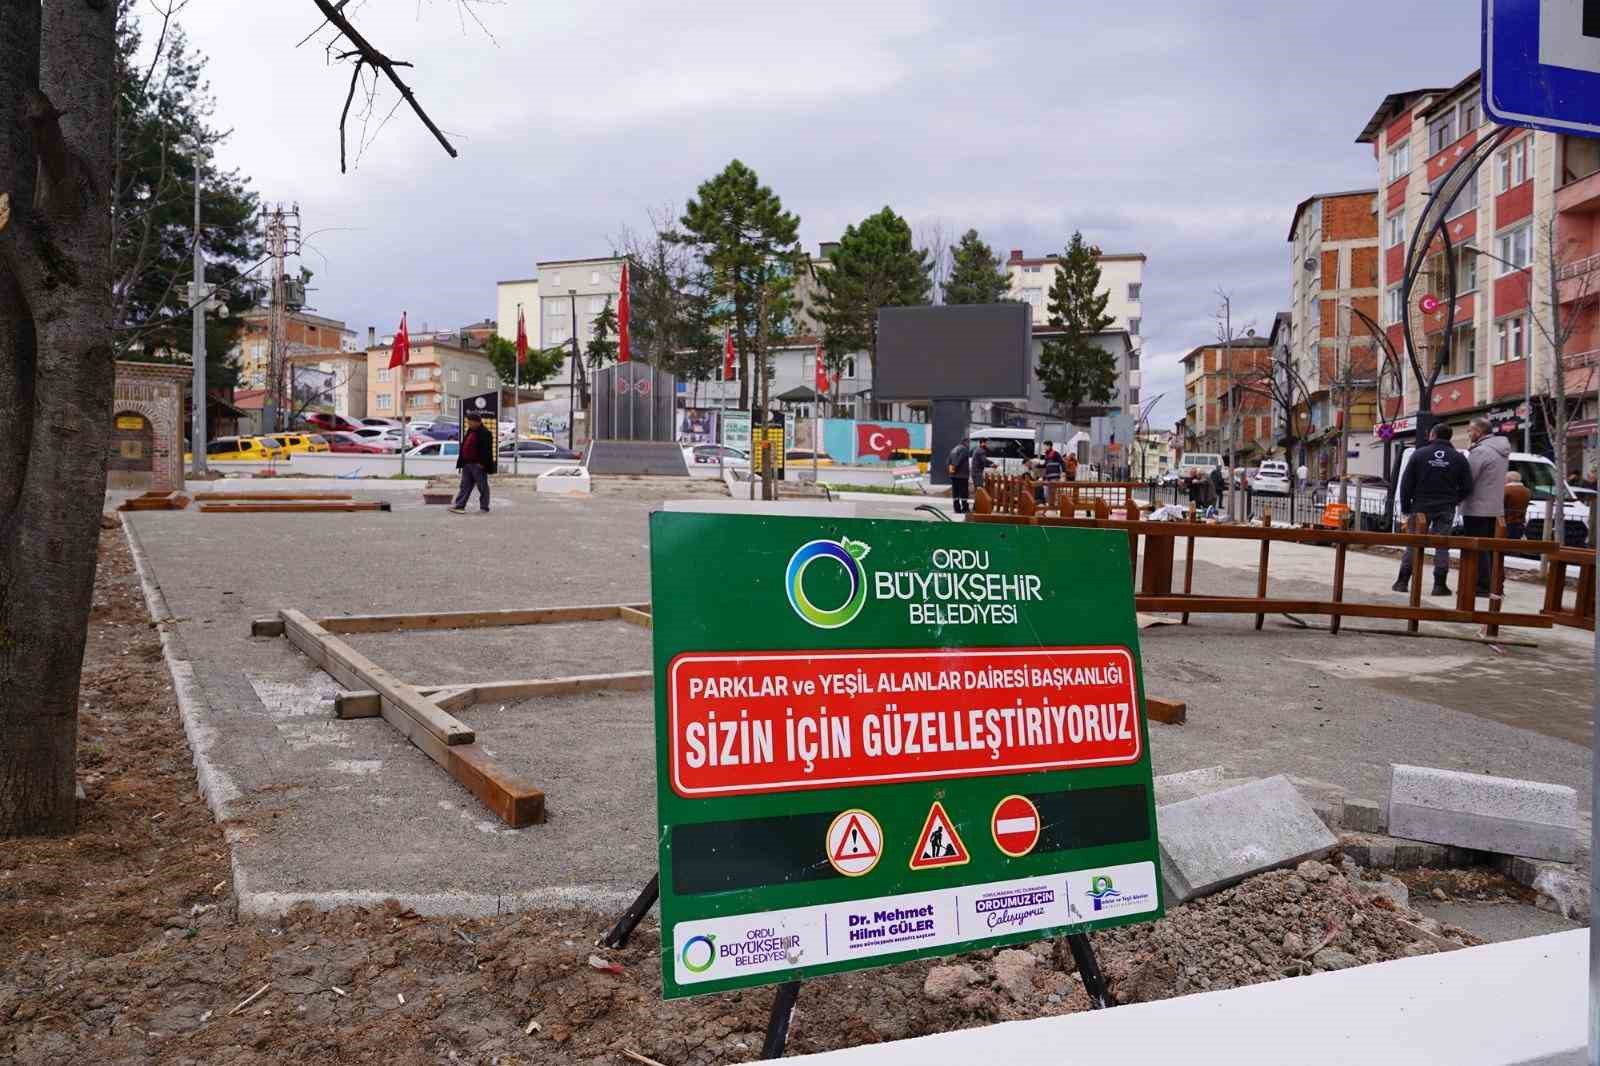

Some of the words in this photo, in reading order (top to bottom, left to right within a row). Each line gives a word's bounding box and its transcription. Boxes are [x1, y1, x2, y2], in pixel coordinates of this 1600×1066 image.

[932, 549, 990, 570] ORDU
[875, 571, 1043, 601] BÜYÜKŞEHİR
[909, 604, 1018, 625] BELEDİYESİ
[688, 676, 789, 699] PARKLAR
[792, 680, 816, 695] ve
[819, 668, 873, 699] YEŞİL
[877, 671, 961, 693] ALANLAR
[964, 664, 1029, 689] DAİRESİ
[1031, 662, 1124, 691] BAŞKANLIĞI
[685, 709, 774, 769] SİZİN
[786, 706, 852, 773] İÇİN
[862, 697, 1132, 760] GÜZELLEŞTİRİYORUZ
[977, 897, 1031, 911] ORDUMUZ
[848, 914, 871, 927] Dr.
[873, 904, 934, 923] Mehmet
[746, 928, 775, 940] ORDU
[849, 925, 886, 941] Hilmi
[888, 919, 934, 936] GÜLER
